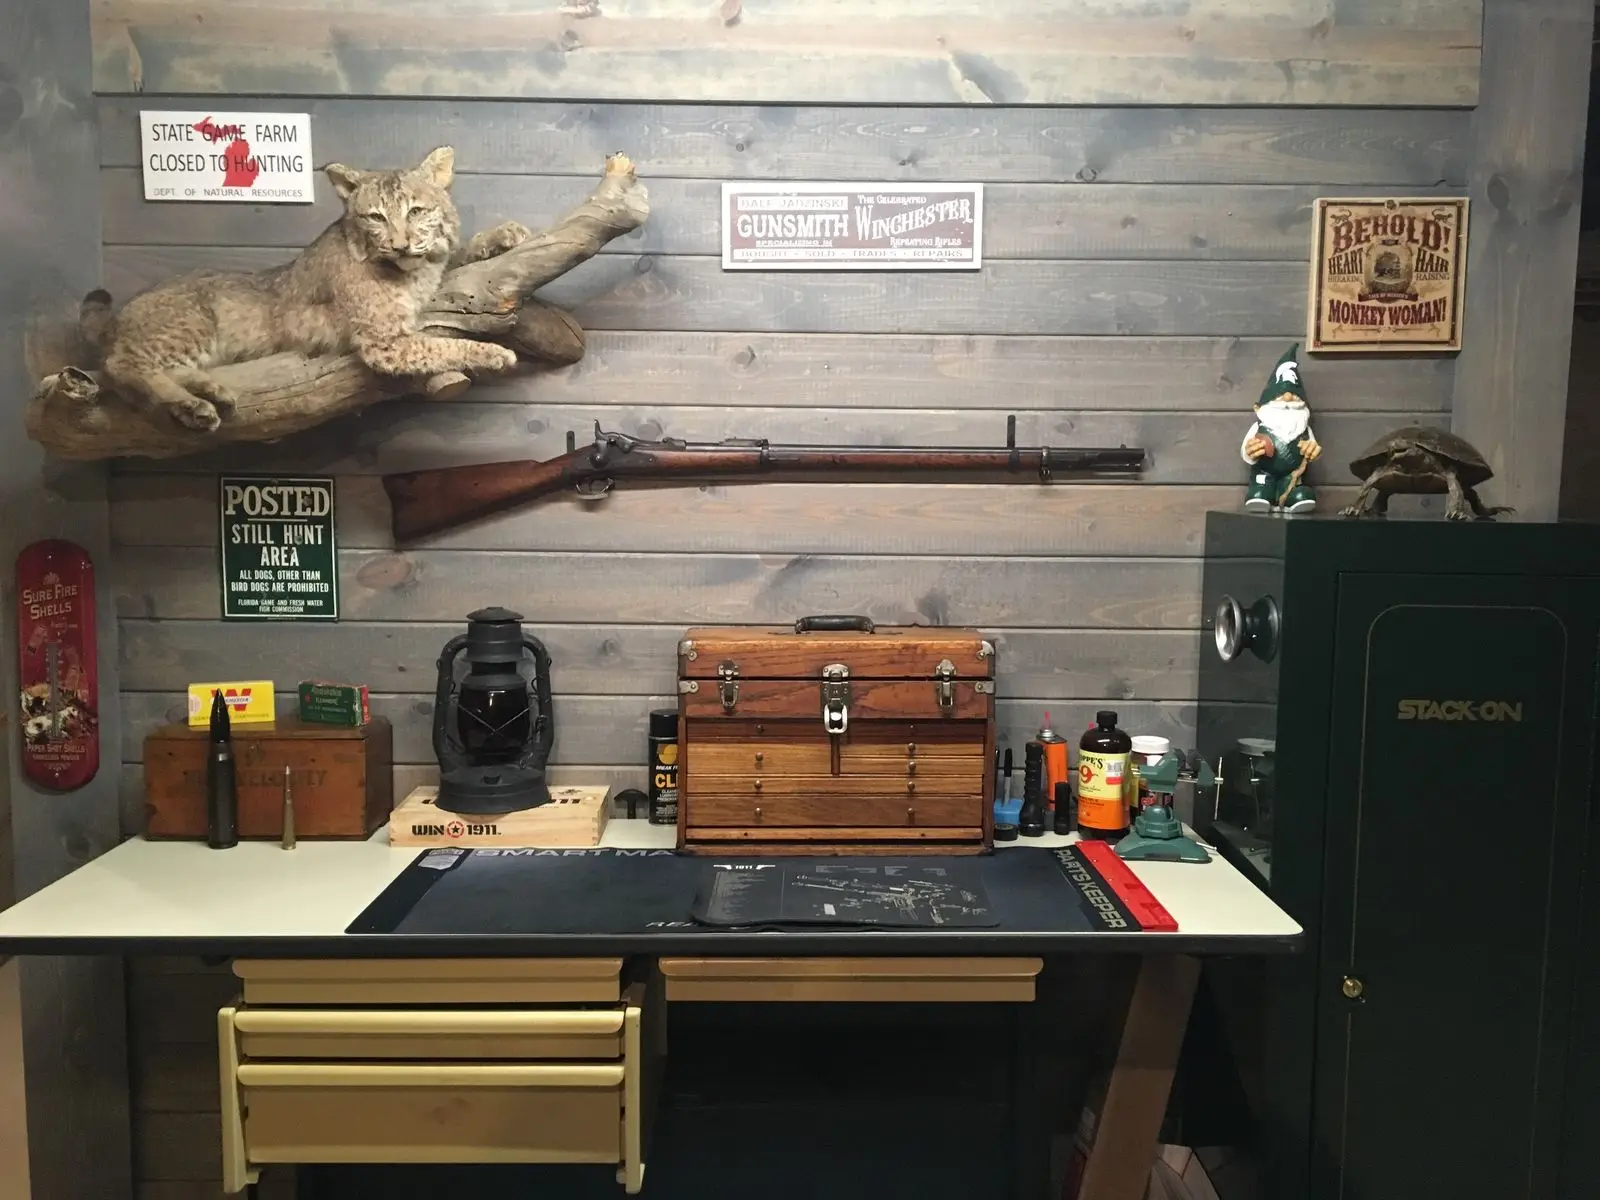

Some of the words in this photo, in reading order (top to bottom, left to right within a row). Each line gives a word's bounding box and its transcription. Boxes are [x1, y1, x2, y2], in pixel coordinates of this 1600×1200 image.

[152, 123, 194, 142] STATE
[202, 123, 247, 142] GAME
[255, 124, 297, 142] FARM
[150, 154, 205, 172] CLOSED
[210, 154, 229, 172] TO
[234, 155, 303, 173] HUNTING
[185, 188, 197, 196] OF
[203, 188, 244, 197] NATURAL
[252, 188, 303, 198] RESOURCES
[737, 213, 849, 238] GUNSMITH
[854, 198, 973, 241] WINCHESTER
[935, 236, 962, 247] RIFLES
[1332, 214, 1451, 256] BEHOLD!
[1328, 248, 1363, 275] HEART
[1414, 248, 1450, 273] HAIR
[1415, 272, 1450, 281] RAISING
[1328, 298, 1386, 325] MONKEY
[1389, 296, 1447, 325] WOMAN!
[225, 485, 330, 517] POSTED
[231, 524, 275, 544] STILL
[283, 524, 324, 545] HUNT
[260, 546, 299, 567] AREA
[239, 569, 252, 580] ALL
[254, 570, 275, 581] DOGS,
[277, 570, 299, 580] OTHER
[301, 570, 320, 580] THAN
[22, 588, 53, 605] SURE
[54, 583, 78, 600] FIRE
[231, 581, 248, 592] BIRD
[250, 582, 269, 592] DOGS
[271, 582, 285, 592] ARE
[287, 582, 329, 593] PROHIBITED
[30, 602, 72, 620] SHELLS
[238, 598, 259, 606] FLORIDA
[1397, 699, 1523, 722] STACK-ON
[655, 773, 678, 788] CL
[411, 824, 445, 836] WIN
[475, 849, 609, 857] SMART
[615, 849, 675, 857] MA
